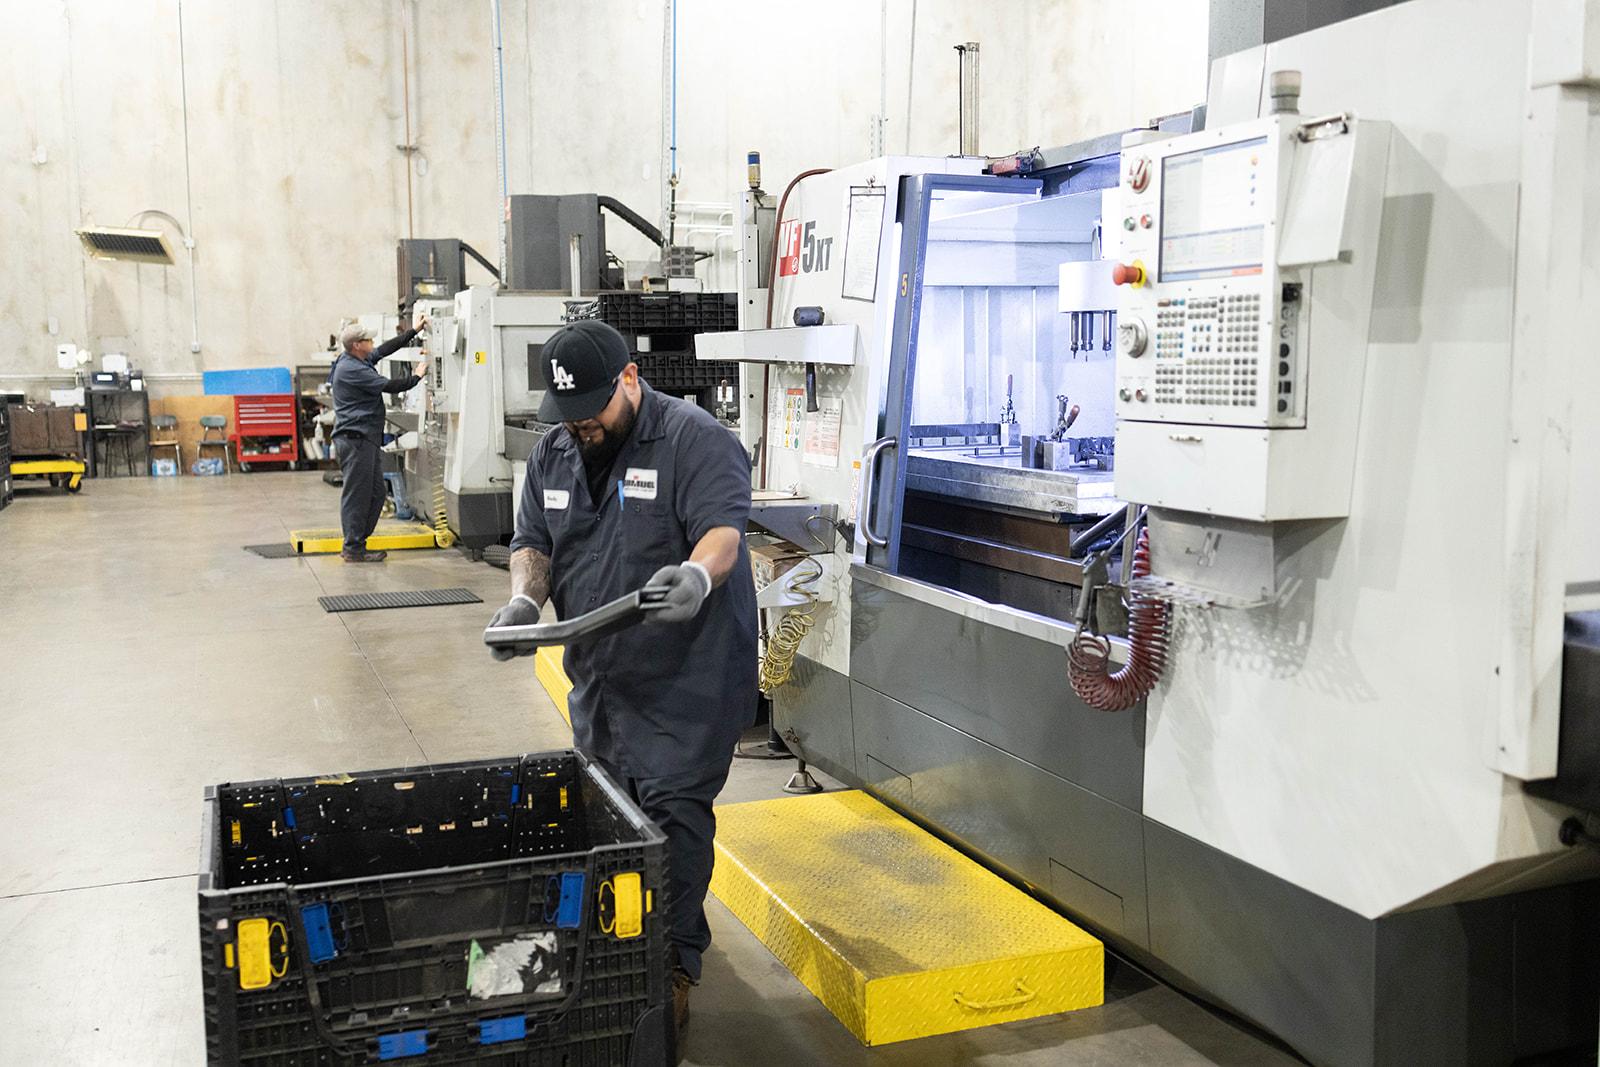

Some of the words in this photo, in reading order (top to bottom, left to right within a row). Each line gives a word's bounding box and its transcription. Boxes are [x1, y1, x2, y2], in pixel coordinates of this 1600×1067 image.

[780, 219, 799, 257] VF
[901, 272, 909, 297] 5
[475, 351, 480, 364] 9
[551, 359, 575, 390] LA
